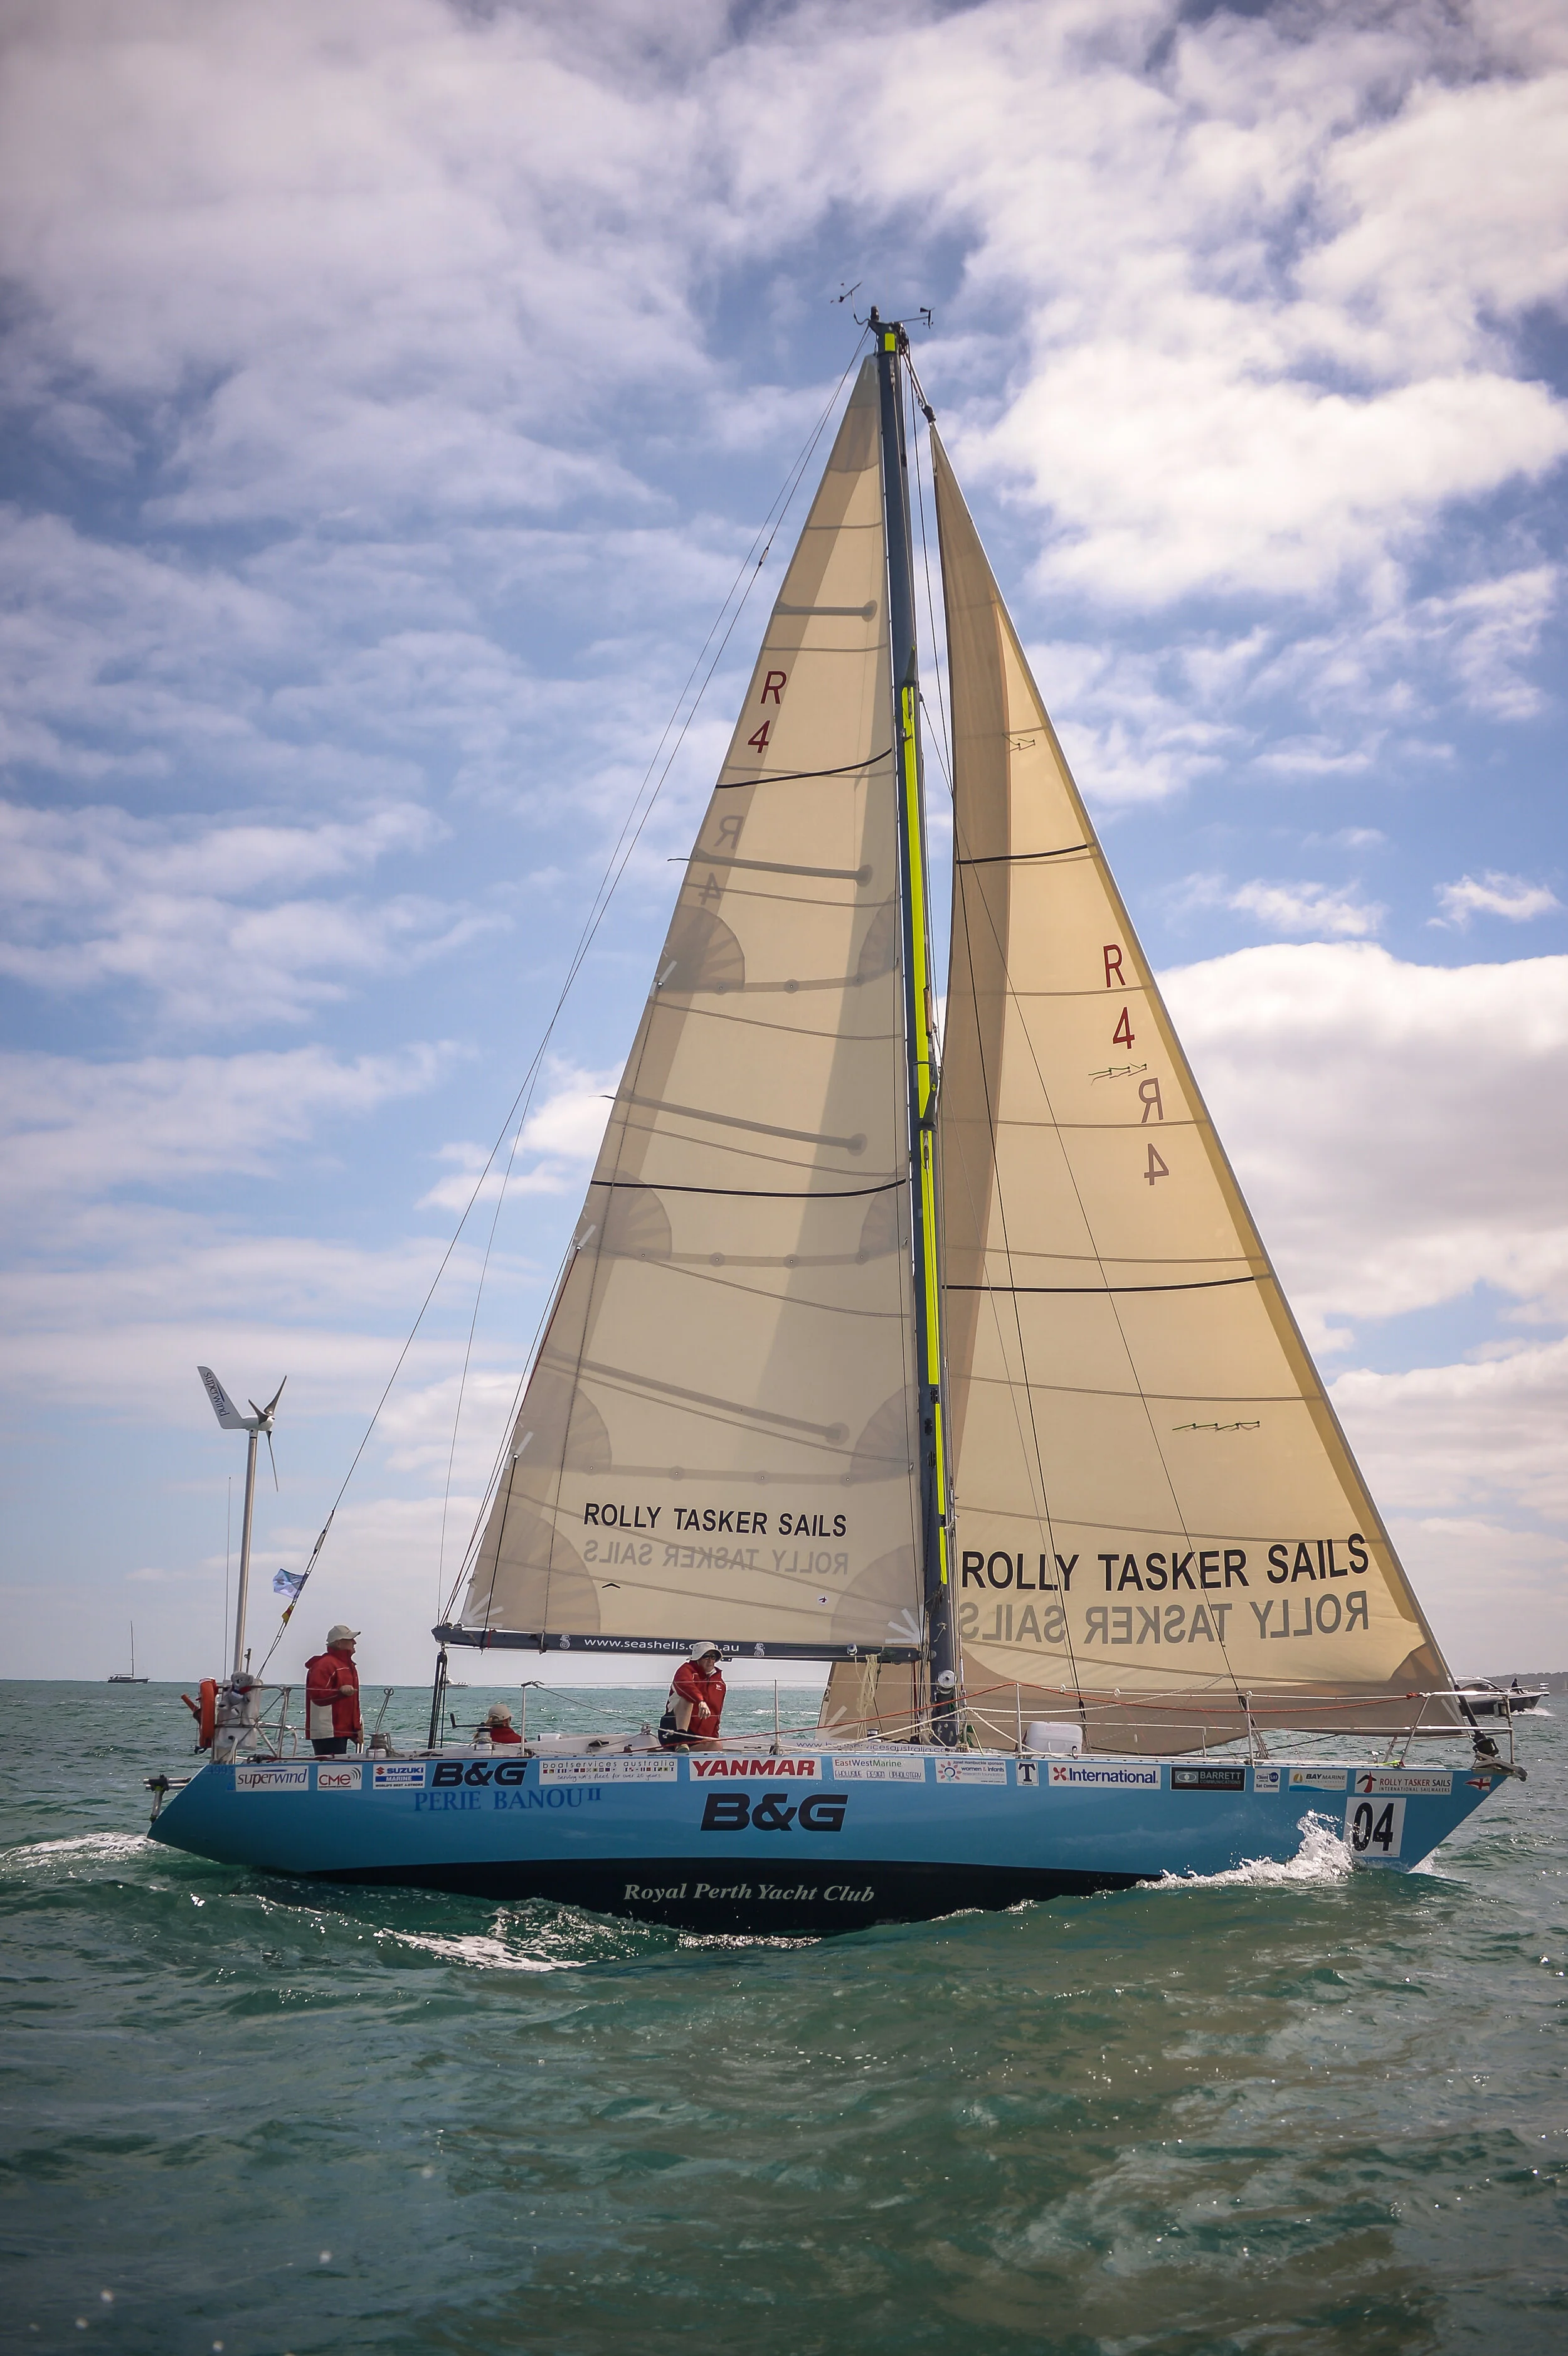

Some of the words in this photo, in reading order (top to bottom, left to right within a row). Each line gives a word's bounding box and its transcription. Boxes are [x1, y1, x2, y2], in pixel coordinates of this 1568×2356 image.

[760, 671, 787, 704] R
[747, 720, 771, 753] 4
[1103, 943, 1126, 988] R
[1113, 1006, 1135, 1049] 4
[204, 1372, 230, 1417] superwind
[583, 1502, 662, 1529] ROLLY
[674, 1507, 768, 1535] TASKER
[778, 1512, 847, 1537] SAILS
[961, 1550, 1080, 1591] ROLLY
[1098, 1549, 1249, 1591] TASKER
[1266, 1532, 1370, 1584] SAILS
[585, 1638, 739, 1652] www.seashells.c.au
[432, 1761, 528, 1787] B&G
[543, 1761, 617, 1769] boatservices
[692, 1759, 815, 1776] YANMAR
[835, 1759, 902, 1767] EastWestMarine
[1018, 1763, 1036, 1782] T
[237, 1768, 307, 1788] superwind
[1069, 1768, 1156, 1783] International
[1200, 1771, 1241, 1780] BARRETT
[1404, 1778, 1430, 1786] TASKER
[414, 1790, 482, 1811] PERIE
[493, 1788, 584, 1810] BANOU
[587, 1788, 602, 1801] II
[700, 1793, 849, 1832] B&G
[1353, 1801, 1394, 1852] 04
[623, 1883, 687, 1903] Royal
[693, 1883, 753, 1899] Perth
[758, 1884, 818, 1901] Yacht
[823, 1884, 875, 1902] Club
